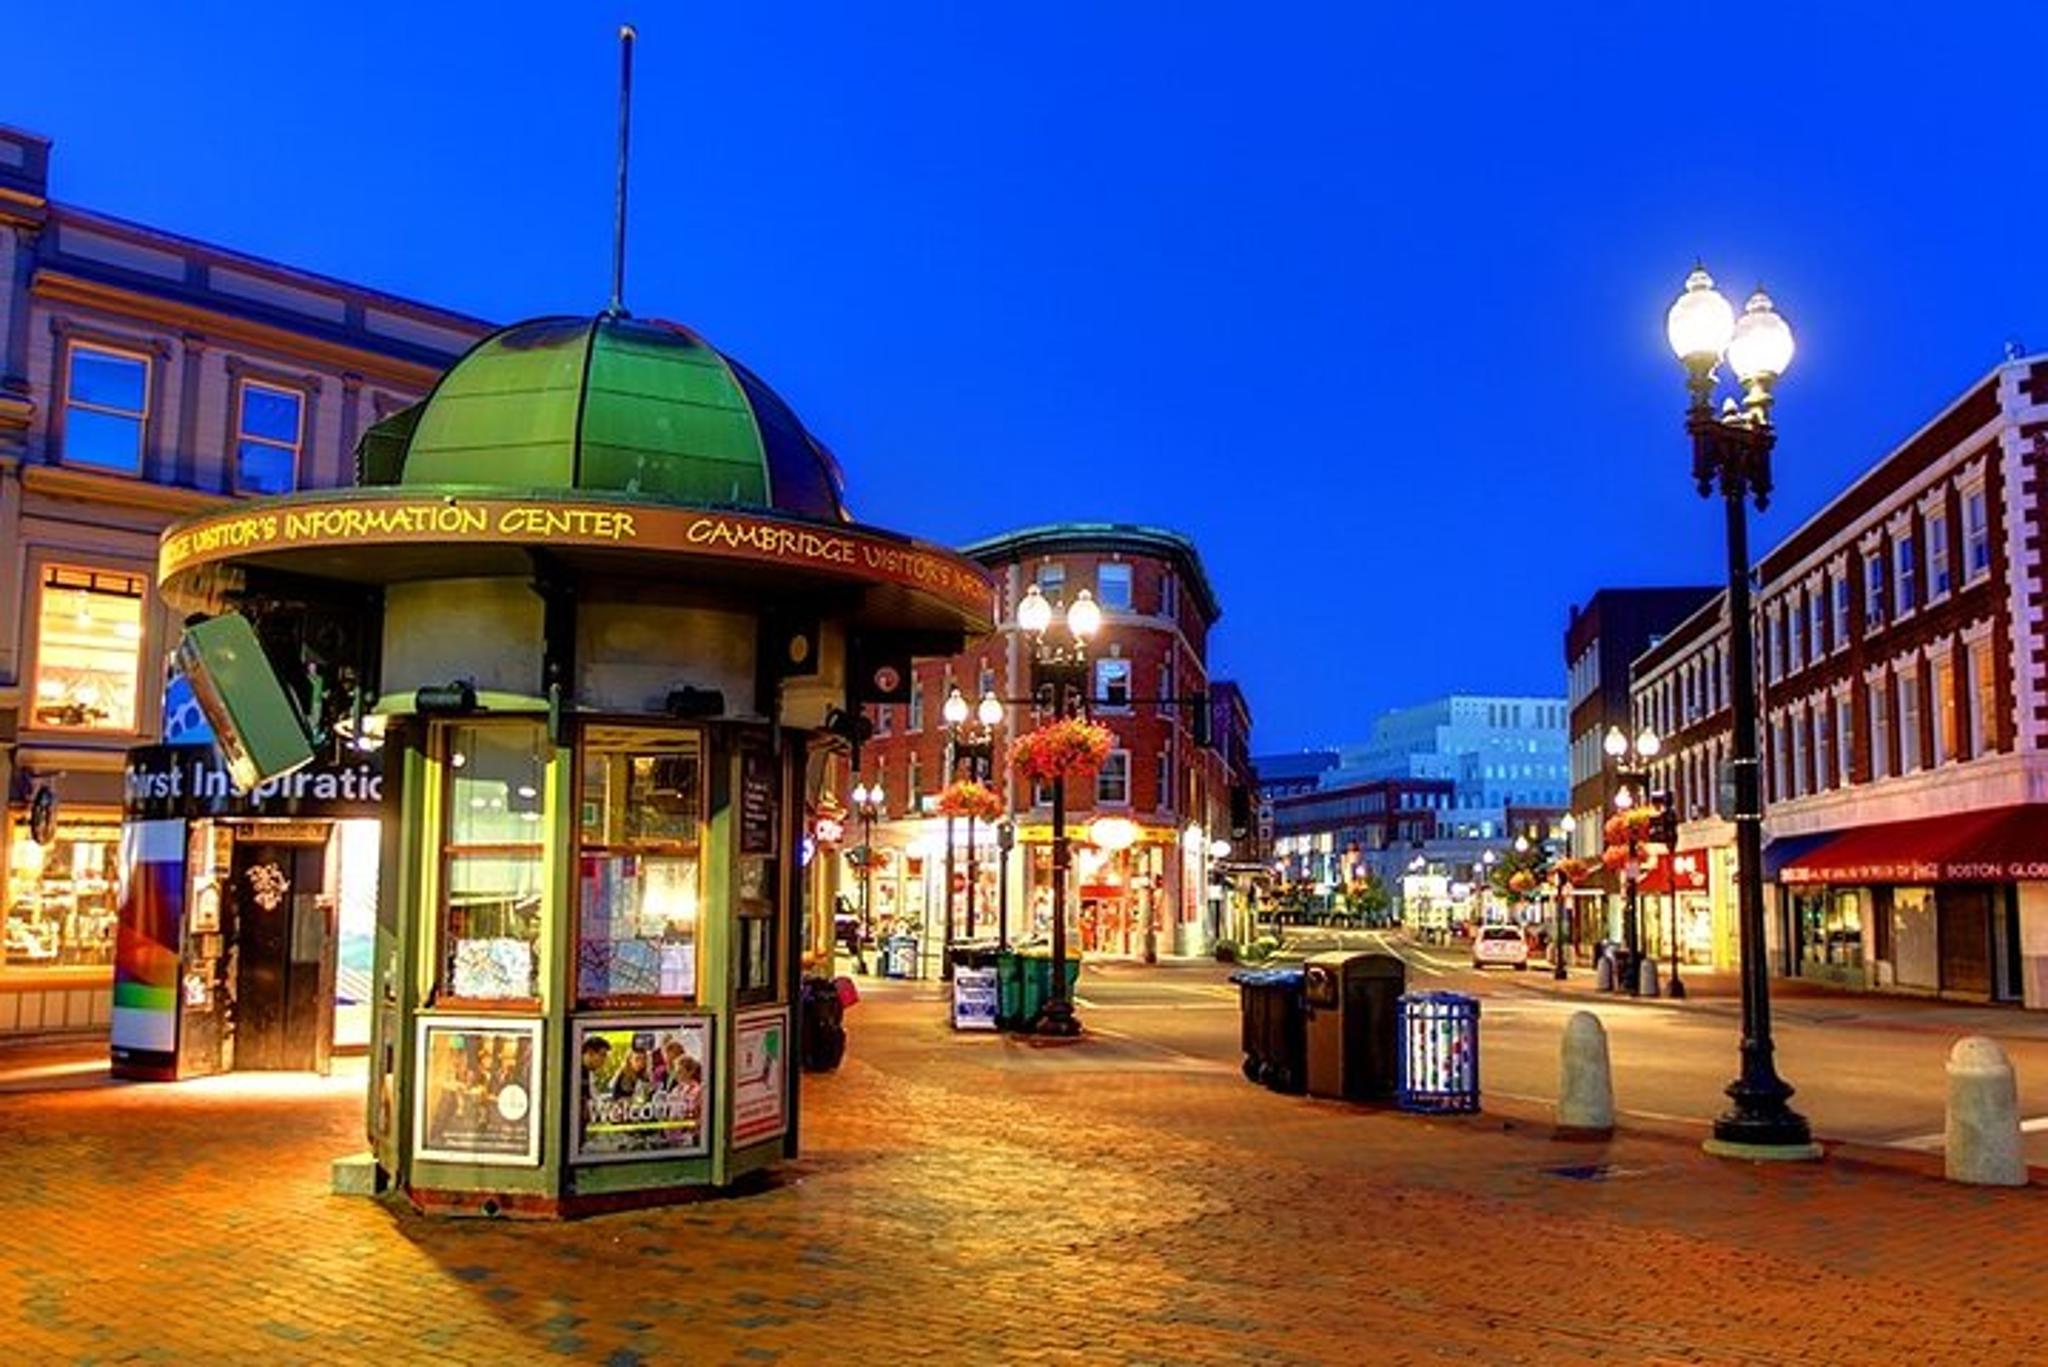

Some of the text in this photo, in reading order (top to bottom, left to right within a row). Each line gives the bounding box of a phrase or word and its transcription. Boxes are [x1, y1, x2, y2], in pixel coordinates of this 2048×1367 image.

[285, 507, 488, 541] INFORMATION
[498, 508, 637, 541] CENTER
[686, 519, 856, 564] CAMBRIDGE
